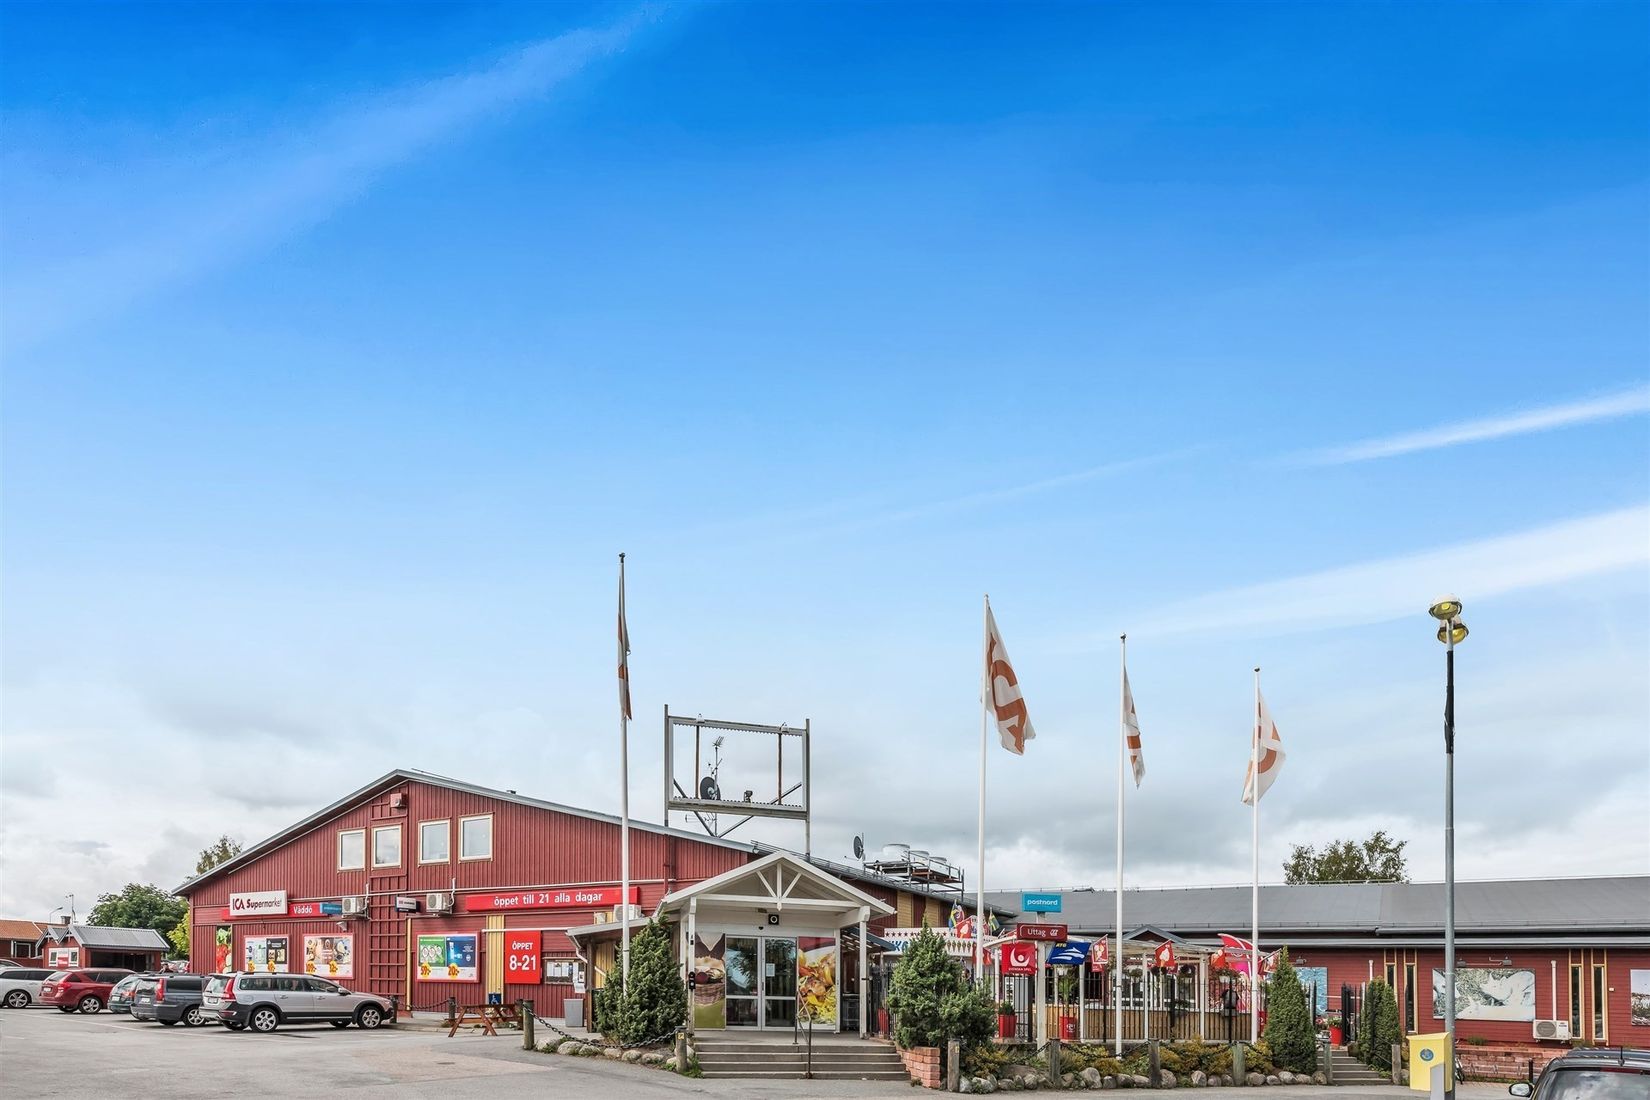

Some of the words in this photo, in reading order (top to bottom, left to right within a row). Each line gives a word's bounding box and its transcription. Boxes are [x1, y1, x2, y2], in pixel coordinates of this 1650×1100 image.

[232, 898, 245, 910] ICA
[246, 897, 282, 910] Supermarket
[494, 896, 519, 907] öppet
[523, 894, 535, 904] till
[539, 893, 549, 904] 21
[554, 892, 570, 903] alla
[575, 892, 603, 904] dagar
[293, 904, 313, 914] Väddö
[1027, 928, 1046, 938] Uttag
[512, 940, 533, 950] ÖPPET
[509, 954, 536, 971] 8-21
